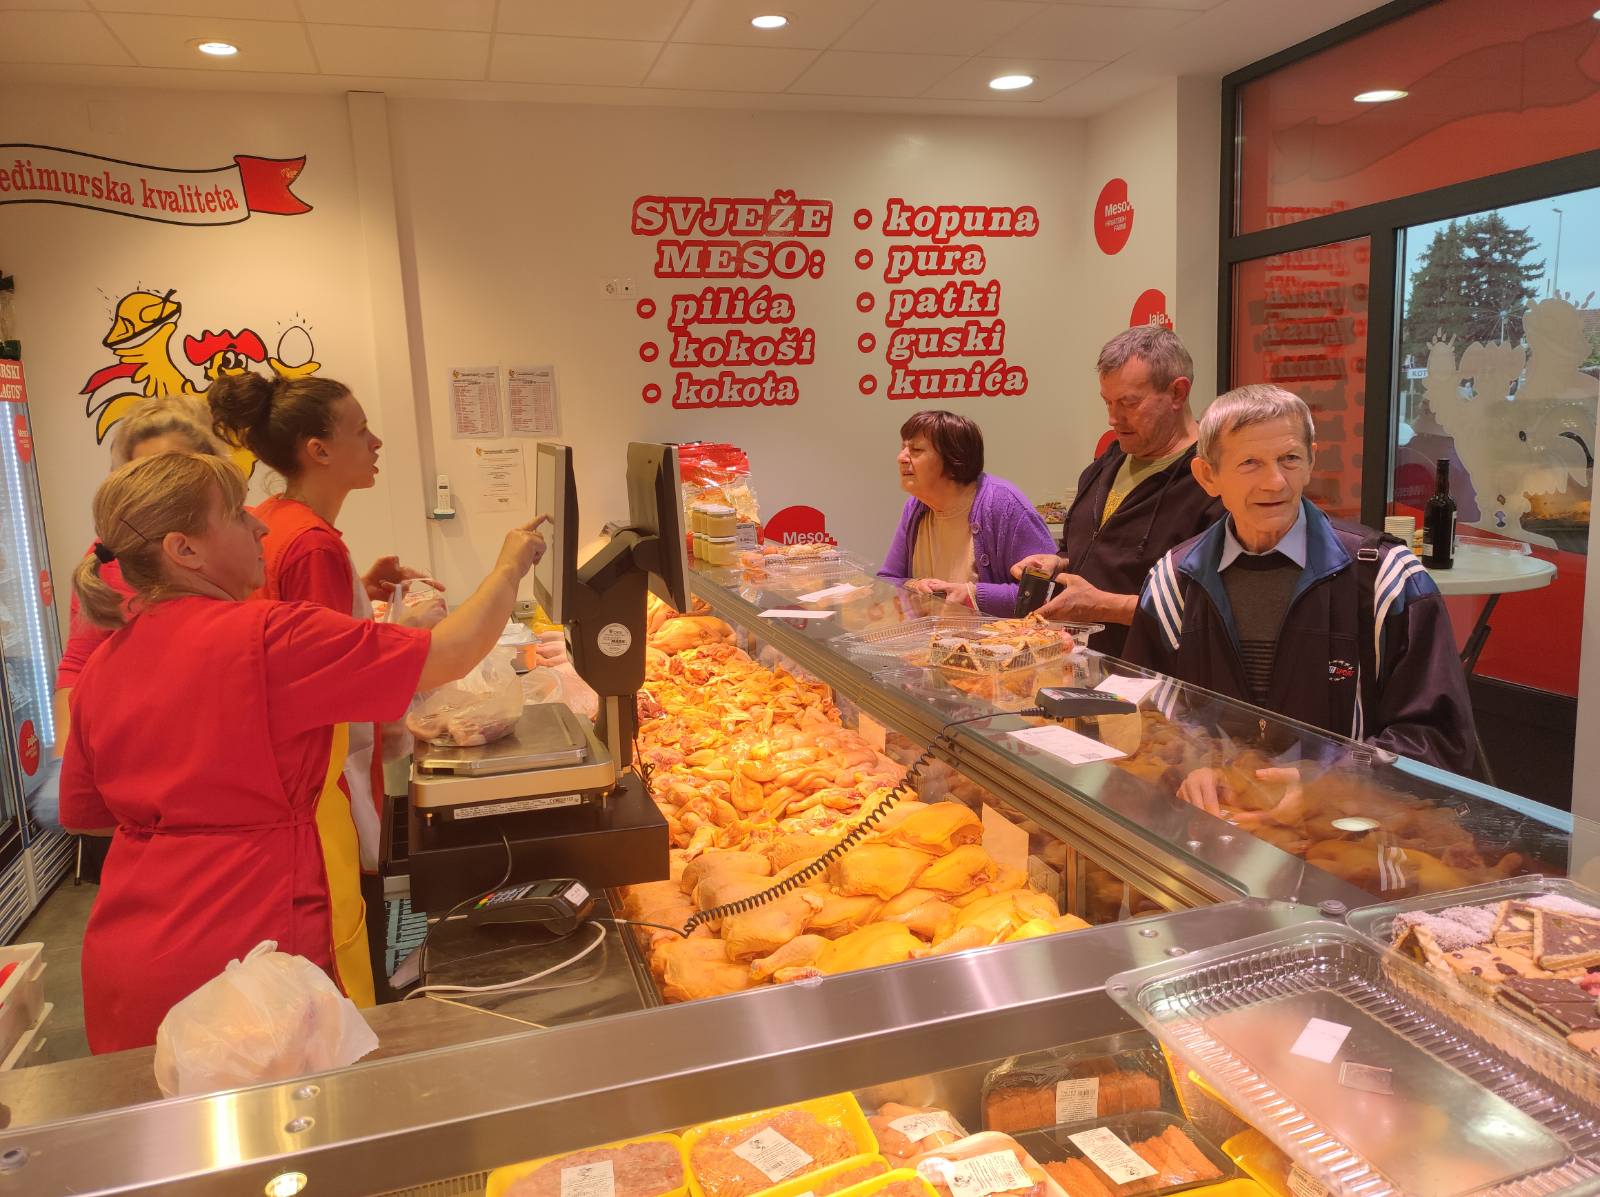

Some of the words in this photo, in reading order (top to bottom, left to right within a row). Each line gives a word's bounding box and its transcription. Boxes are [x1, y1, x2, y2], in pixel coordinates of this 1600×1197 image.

[141, 178, 239, 213] kvaliteta
[631, 189, 833, 237] SVJEŽE
[882, 197, 1040, 244] kopuna
[654, 239, 826, 279] MESO:
[884, 244, 986, 284] pura
[667, 285, 795, 332] pilića
[885, 279, 1001, 328] patki
[669, 327, 815, 368] kokoši
[886, 319, 1005, 366] guski
[672, 370, 799, 409] kokota
[887, 358, 1029, 400] kunića
